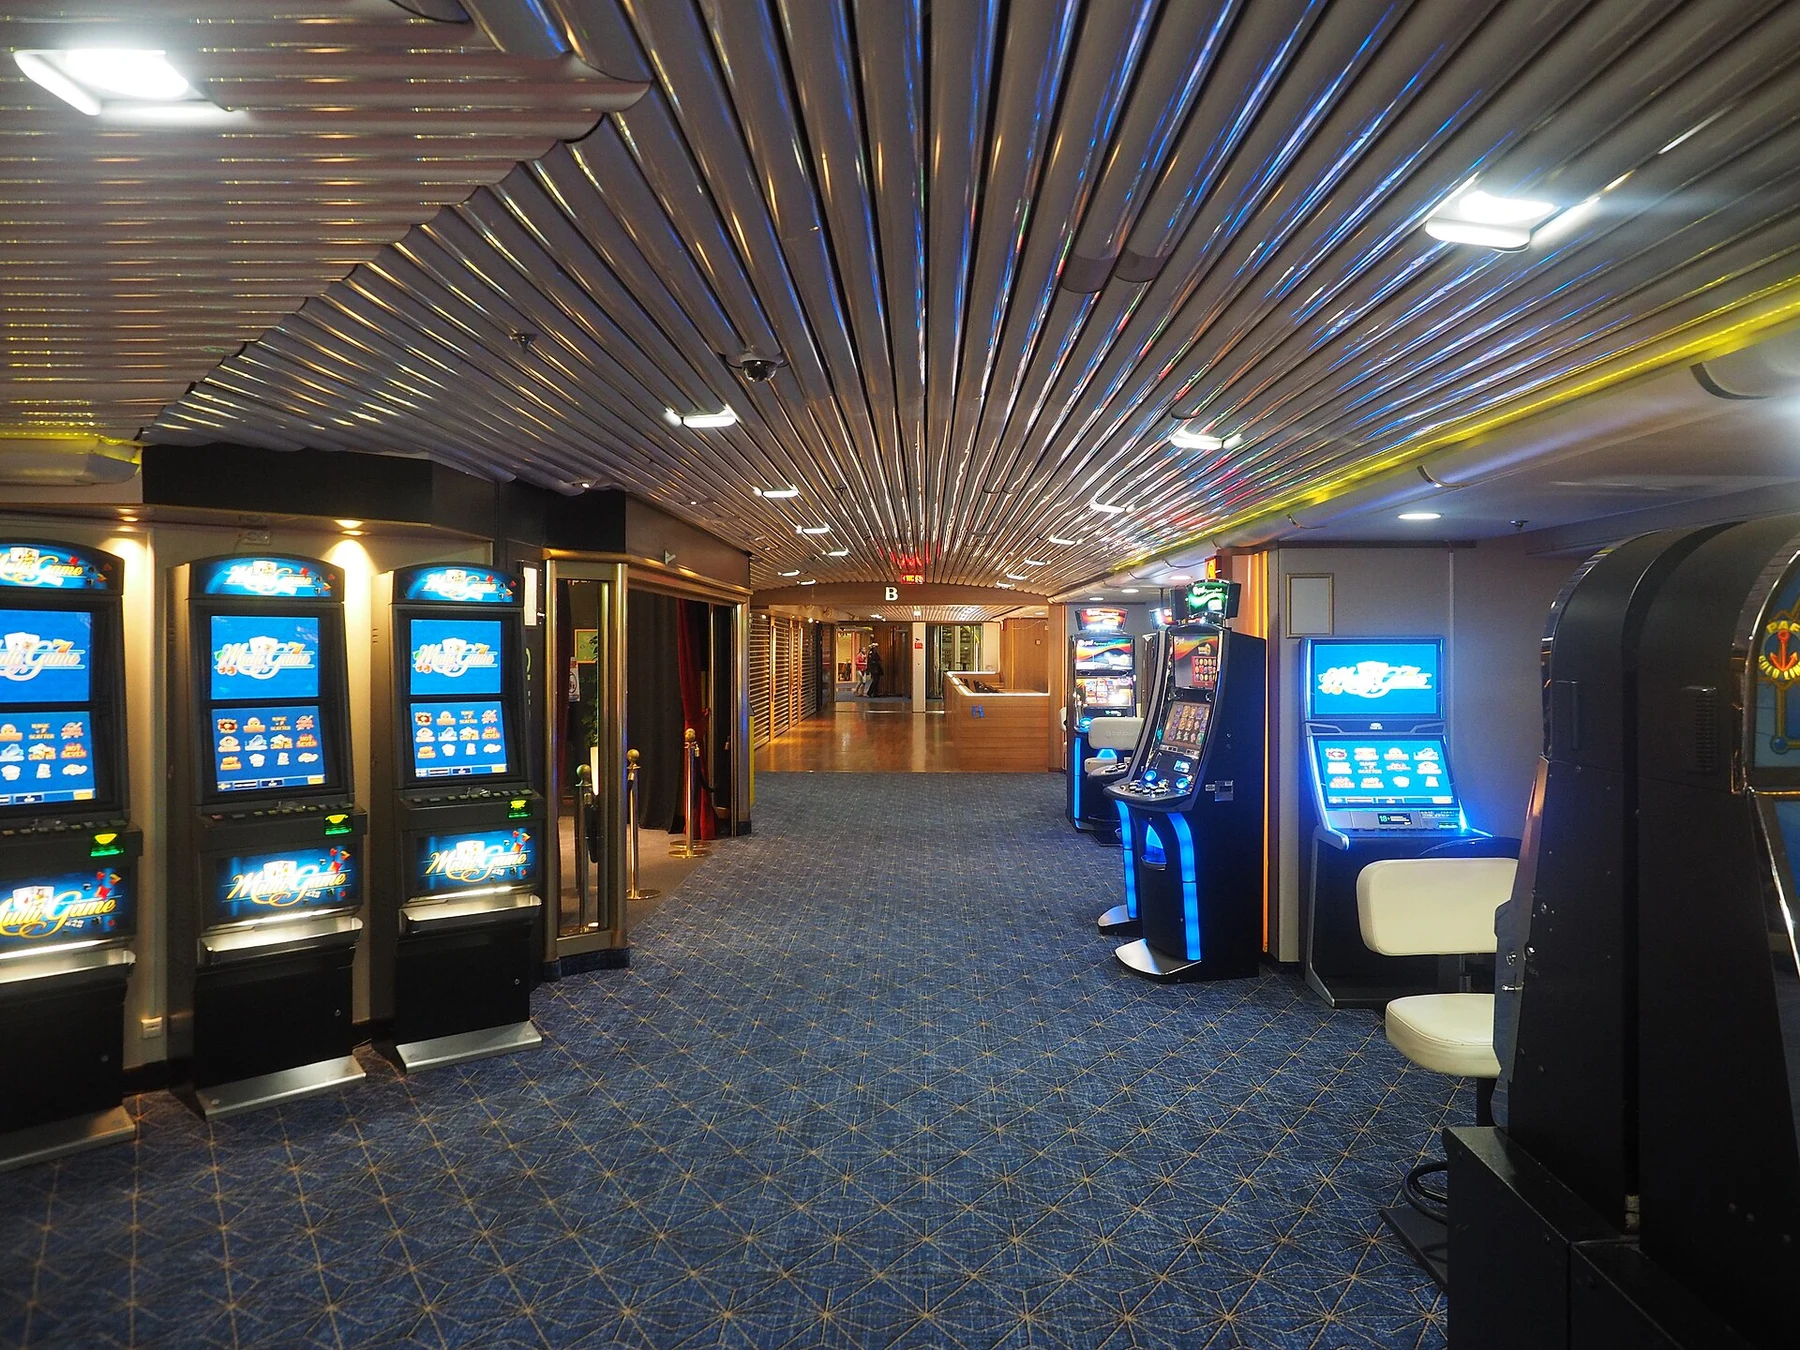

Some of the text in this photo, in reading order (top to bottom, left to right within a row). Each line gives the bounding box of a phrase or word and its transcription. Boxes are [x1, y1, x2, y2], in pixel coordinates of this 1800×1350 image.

[885, 586, 899, 601] B
[425, 844, 527, 882] Multi Game
[226, 864, 347, 907] Multi Game
[46, 890, 117, 938] Game
